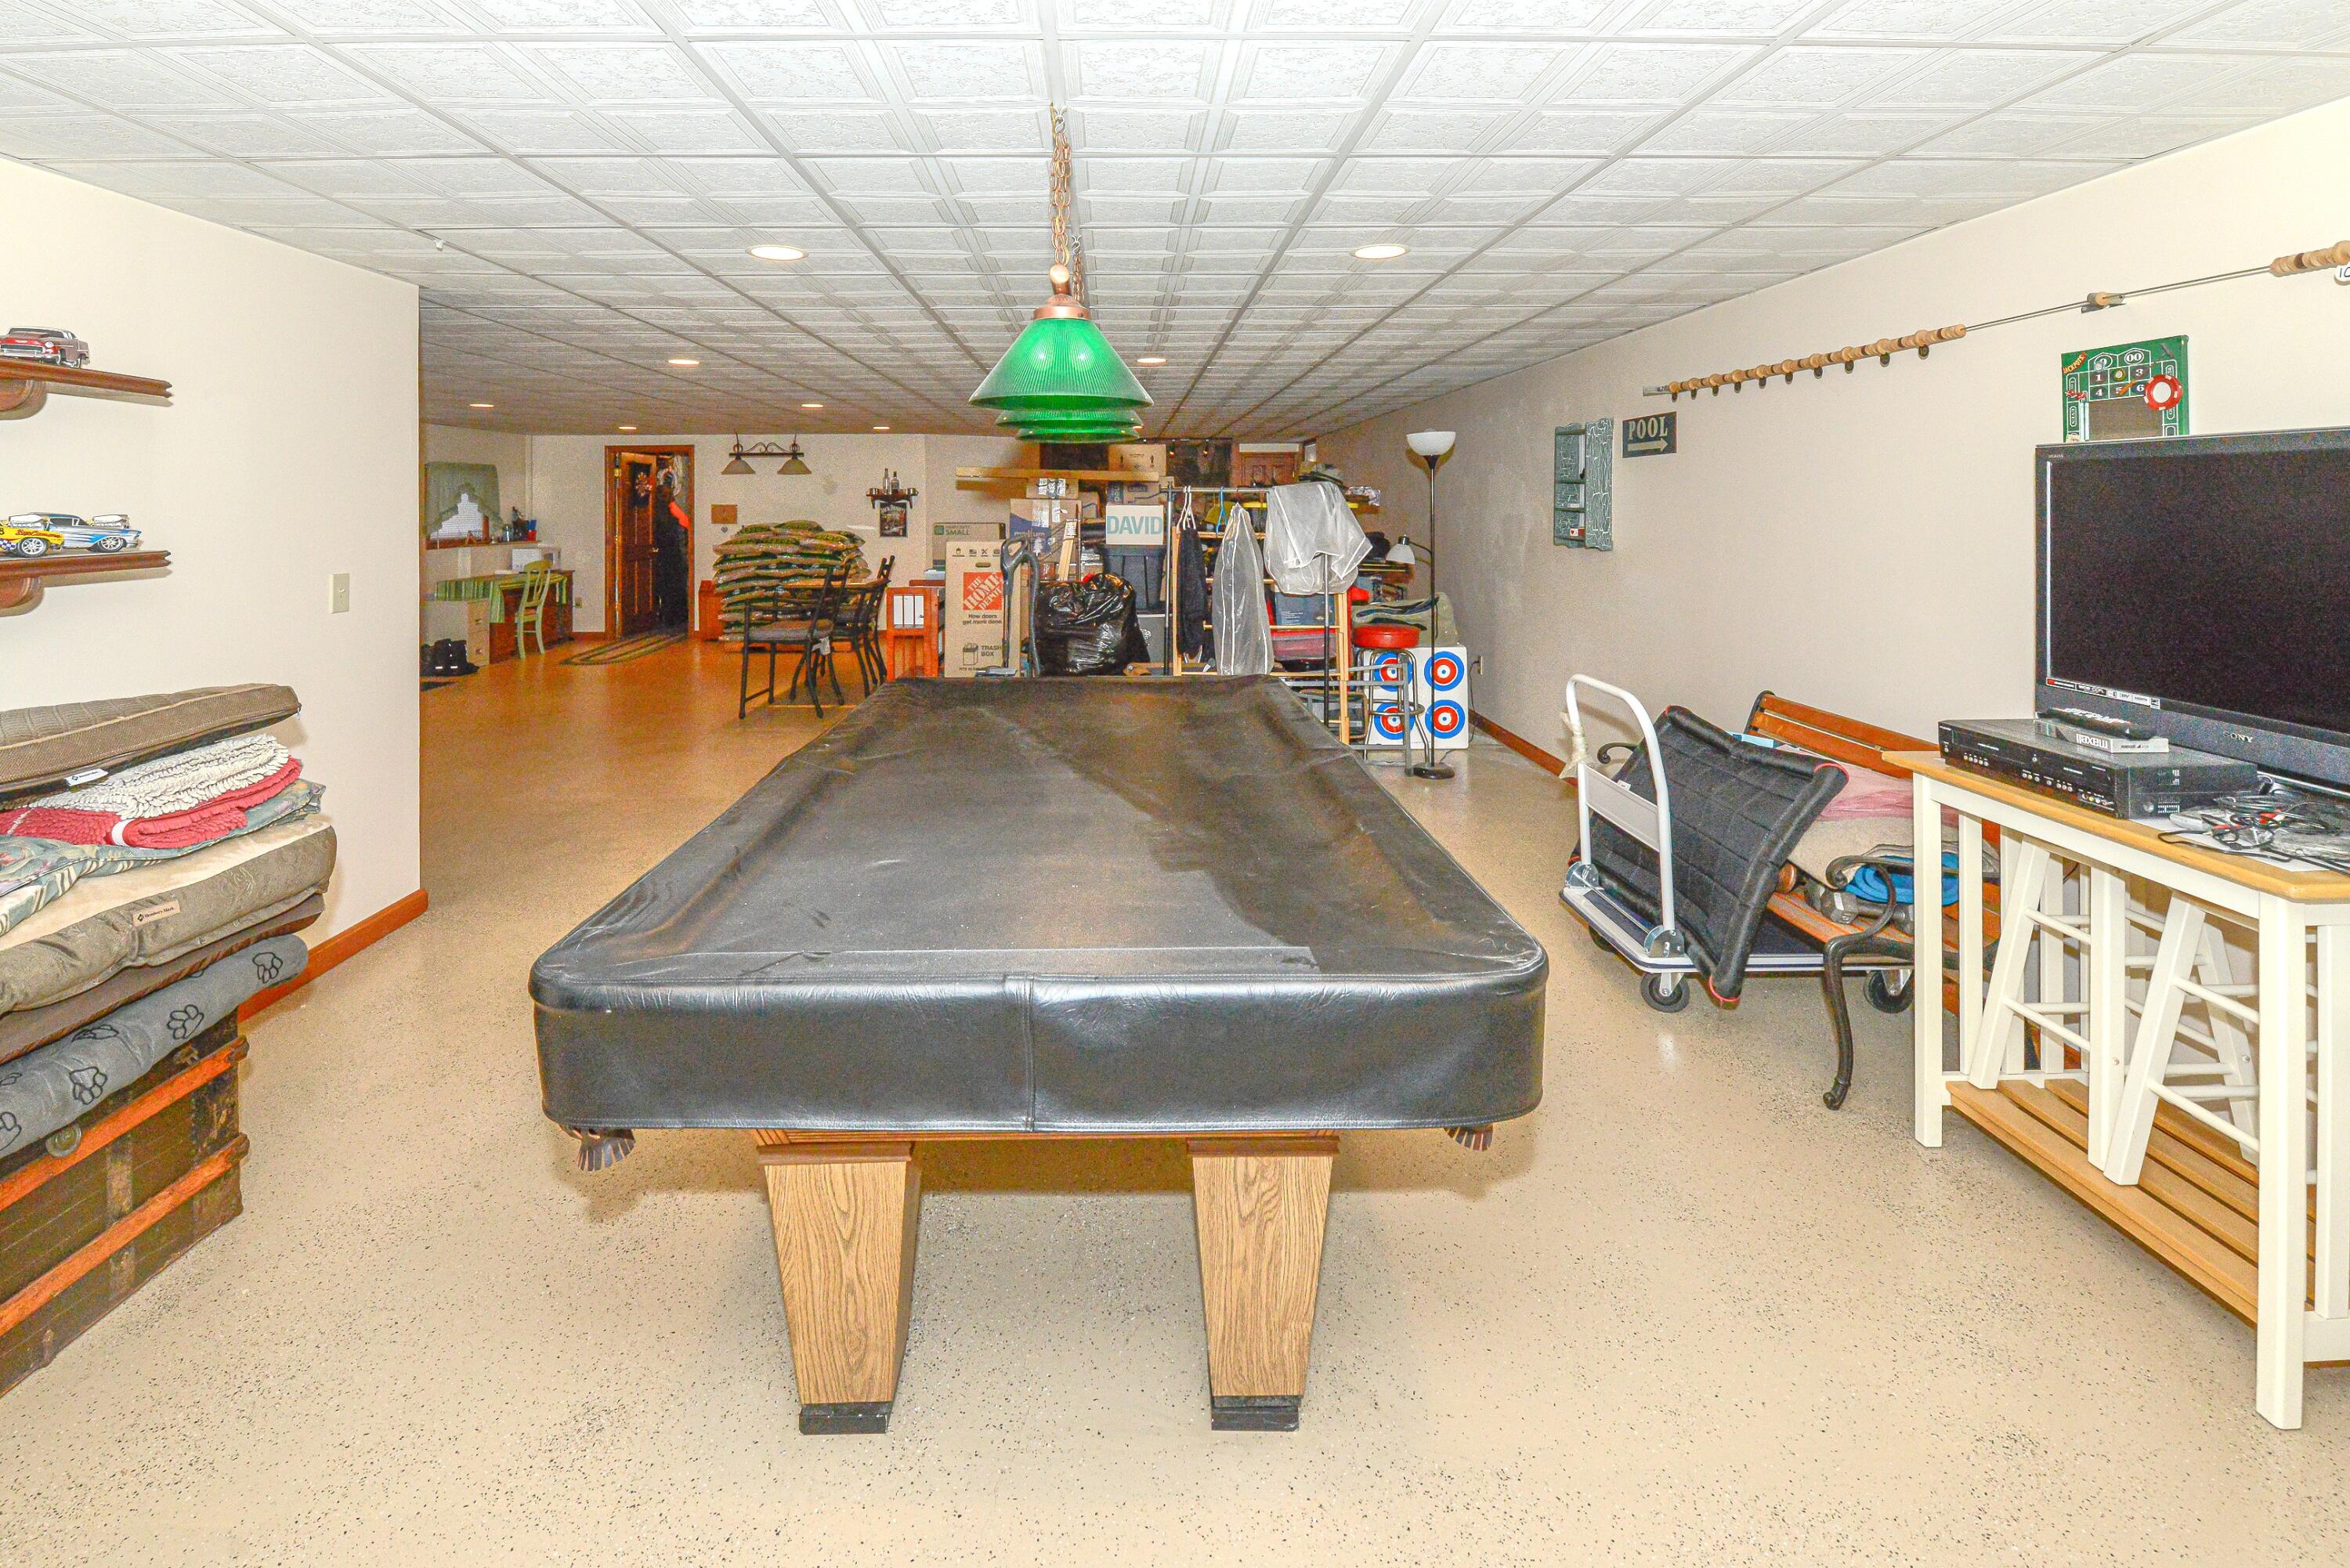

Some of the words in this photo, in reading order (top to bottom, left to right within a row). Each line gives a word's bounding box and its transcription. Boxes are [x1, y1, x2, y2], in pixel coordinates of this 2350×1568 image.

[2126, 352, 2142, 362] 00
[2095, 374, 2102, 382] 1
[2135, 368, 2144, 377] 3
[1628, 417, 1668, 440] POOL
[1107, 515, 1163, 534] DAVID
[967, 576, 982, 591] THE
[964, 573, 1003, 610] HOME
[2076, 733, 2108, 749] maxell
[2222, 732, 2254, 742] SONY
